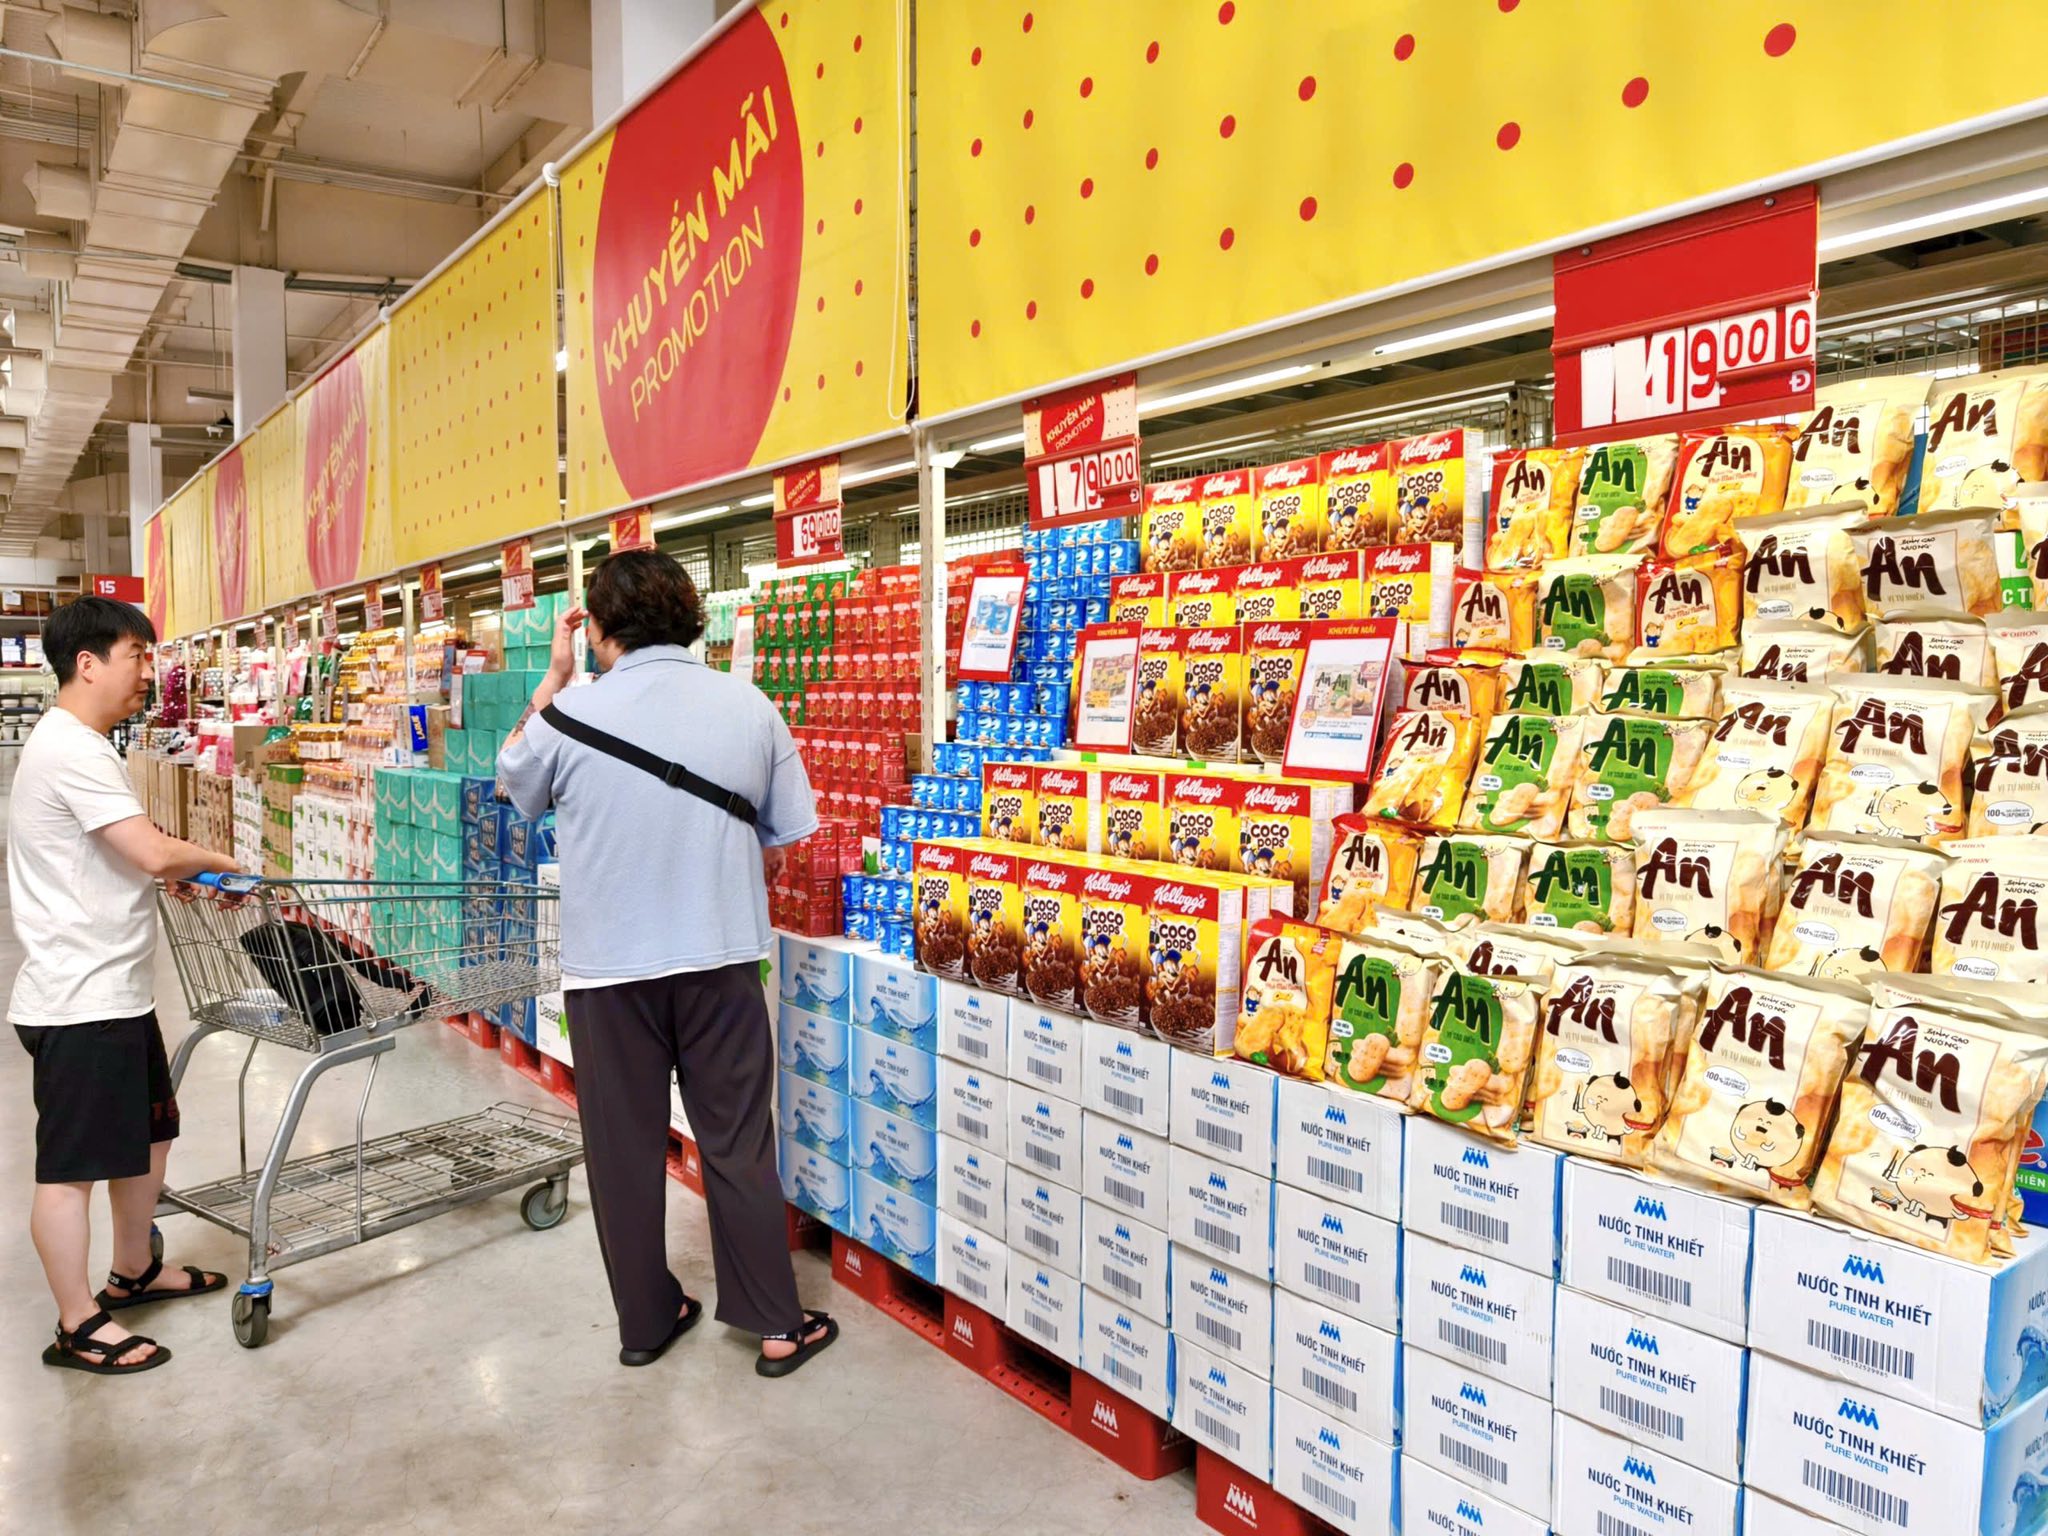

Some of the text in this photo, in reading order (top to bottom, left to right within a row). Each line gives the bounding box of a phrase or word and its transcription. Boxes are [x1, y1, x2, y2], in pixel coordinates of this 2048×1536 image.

[602, 85, 777, 386] KHUYẾN MÃI
[630, 205, 764, 422] PROMOTION
[1055, 414, 1094, 450] PROMOTION
[1795, 405, 1861, 462] An
[1928, 392, 1998, 453] An
[1332, 450, 1378, 472] Kellogg's
[1401, 437, 1452, 462] Kellogg's
[1696, 436, 1752, 477] An
[1507, 460, 1545, 498] An
[1579, 447, 1635, 495] An
[1343, 494, 1366, 507] pops
[1413, 483, 1439, 499] pops
[1375, 548, 1422, 571] Kellogg's
[1745, 534, 1815, 592] An
[1860, 536, 1946, 602] An
[98, 580, 116, 594] 15
[1385, 595, 1409, 607] pops
[1461, 583, 1501, 621] An
[1542, 574, 1596, 625] An
[1649, 574, 1703, 615] An
[1254, 624, 1302, 647] Kellogg's
[1744, 644, 1808, 683] An
[1881, 631, 1961, 681] An
[1265, 670, 1289, 681] pops
[1413, 669, 1461, 706] An
[1504, 664, 1562, 715] An
[1601, 669, 1668, 714] An
[1402, 713, 1447, 752] An
[1484, 715, 1544, 771] An
[1714, 702, 1791, 747] An
[1835, 697, 1928, 755] An
[1582, 718, 1657, 780] An
[992, 765, 1028, 788] Kellogg's
[1041, 770, 1078, 793] Kellogg's
[1109, 774, 1150, 798] Kellogg's
[1174, 777, 1223, 803] Kellogg's
[1001, 808, 1019, 817] pops
[1245, 785, 1299, 812] Kellogg's
[1050, 815, 1069, 825] pops
[1120, 821, 1139, 831] pops
[1185, 827, 1209, 838] pops
[919, 846, 955, 870] Kellogg's
[1257, 837, 1285, 849] pops
[1345, 834, 1380, 872] An
[970, 853, 1009, 879] Kellogg's
[1027, 863, 1067, 889] Kellogg's
[1417, 840, 1477, 899] An
[1527, 851, 1601, 905] An
[1636, 837, 1714, 900] An
[1790, 852, 1875, 918] An
[929, 891, 946, 900] pops
[1084, 872, 1132, 900] Kellogg's
[1154, 883, 1207, 914] Kellogg's
[980, 900, 999, 911] pops
[1036, 912, 1057, 923] pops
[1939, 871, 2039, 950] An
[1096, 924, 1120, 936] pops
[1165, 940, 1192, 952] pops
[1258, 938, 1297, 983] An
[1336, 954, 1389, 1021] An
[1430, 971, 1491, 1044] An
[1546, 975, 1619, 1045] An
[1699, 986, 1786, 1071] An
[1861, 1016, 1962, 1113] An
[1598, 1214, 1704, 1256] NƯỚC TINH KHIẾT
[1623, 1237, 1675, 1260] PURE WATER
[1797, 1271, 1932, 1325] NƯỚC TINH KHIẾT
[1828, 1299, 1894, 1328] PURE WATER
[1590, 1342, 1696, 1392] NƯỚC TINH KHIẾT
[1615, 1368, 1667, 1394] PURE WATER
[1793, 1411, 1926, 1474] NƯỚC TINH KHIẾT
[1824, 1441, 1888, 1474] PURE WATER
[1588, 1467, 1693, 1523] NƯỚC TINH KHIẾT
[1613, 1494, 1664, 1524] PURE WATER
